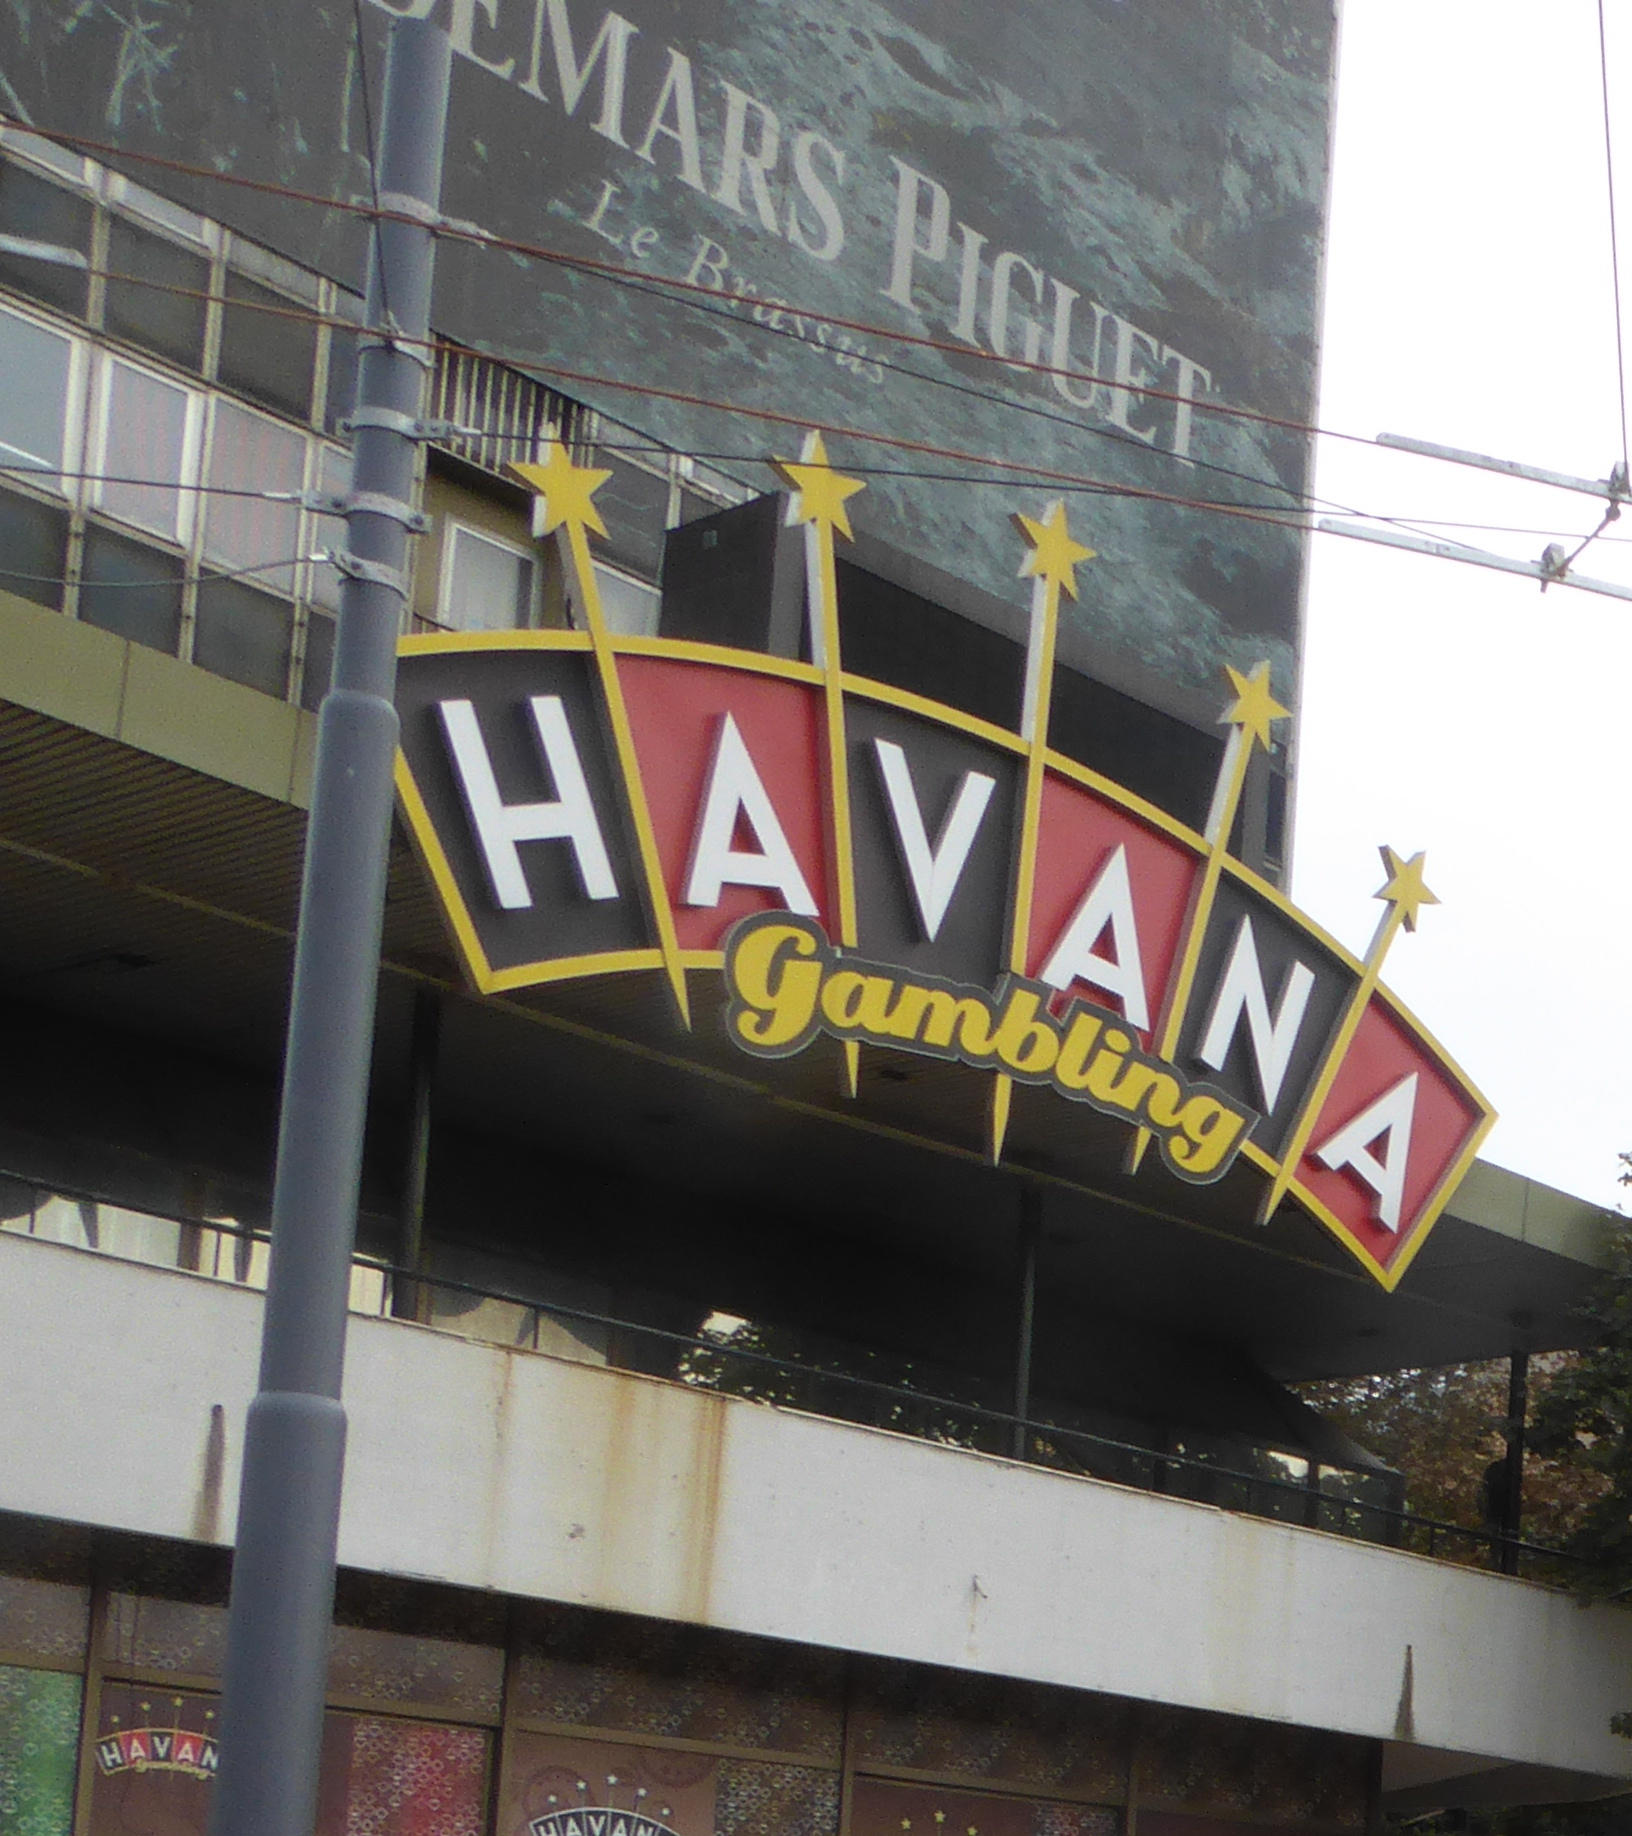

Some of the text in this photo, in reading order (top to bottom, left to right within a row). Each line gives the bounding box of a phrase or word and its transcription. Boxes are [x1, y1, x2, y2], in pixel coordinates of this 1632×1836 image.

[366, 0, 1212, 469] EMARS PIGUET
[581, 179, 890, 384] Le Brassus
[437, 693, 1420, 1234] HAVANA
[733, 922, 1249, 1175] Gambling
[101, 1735, 219, 1771] HAVAN
